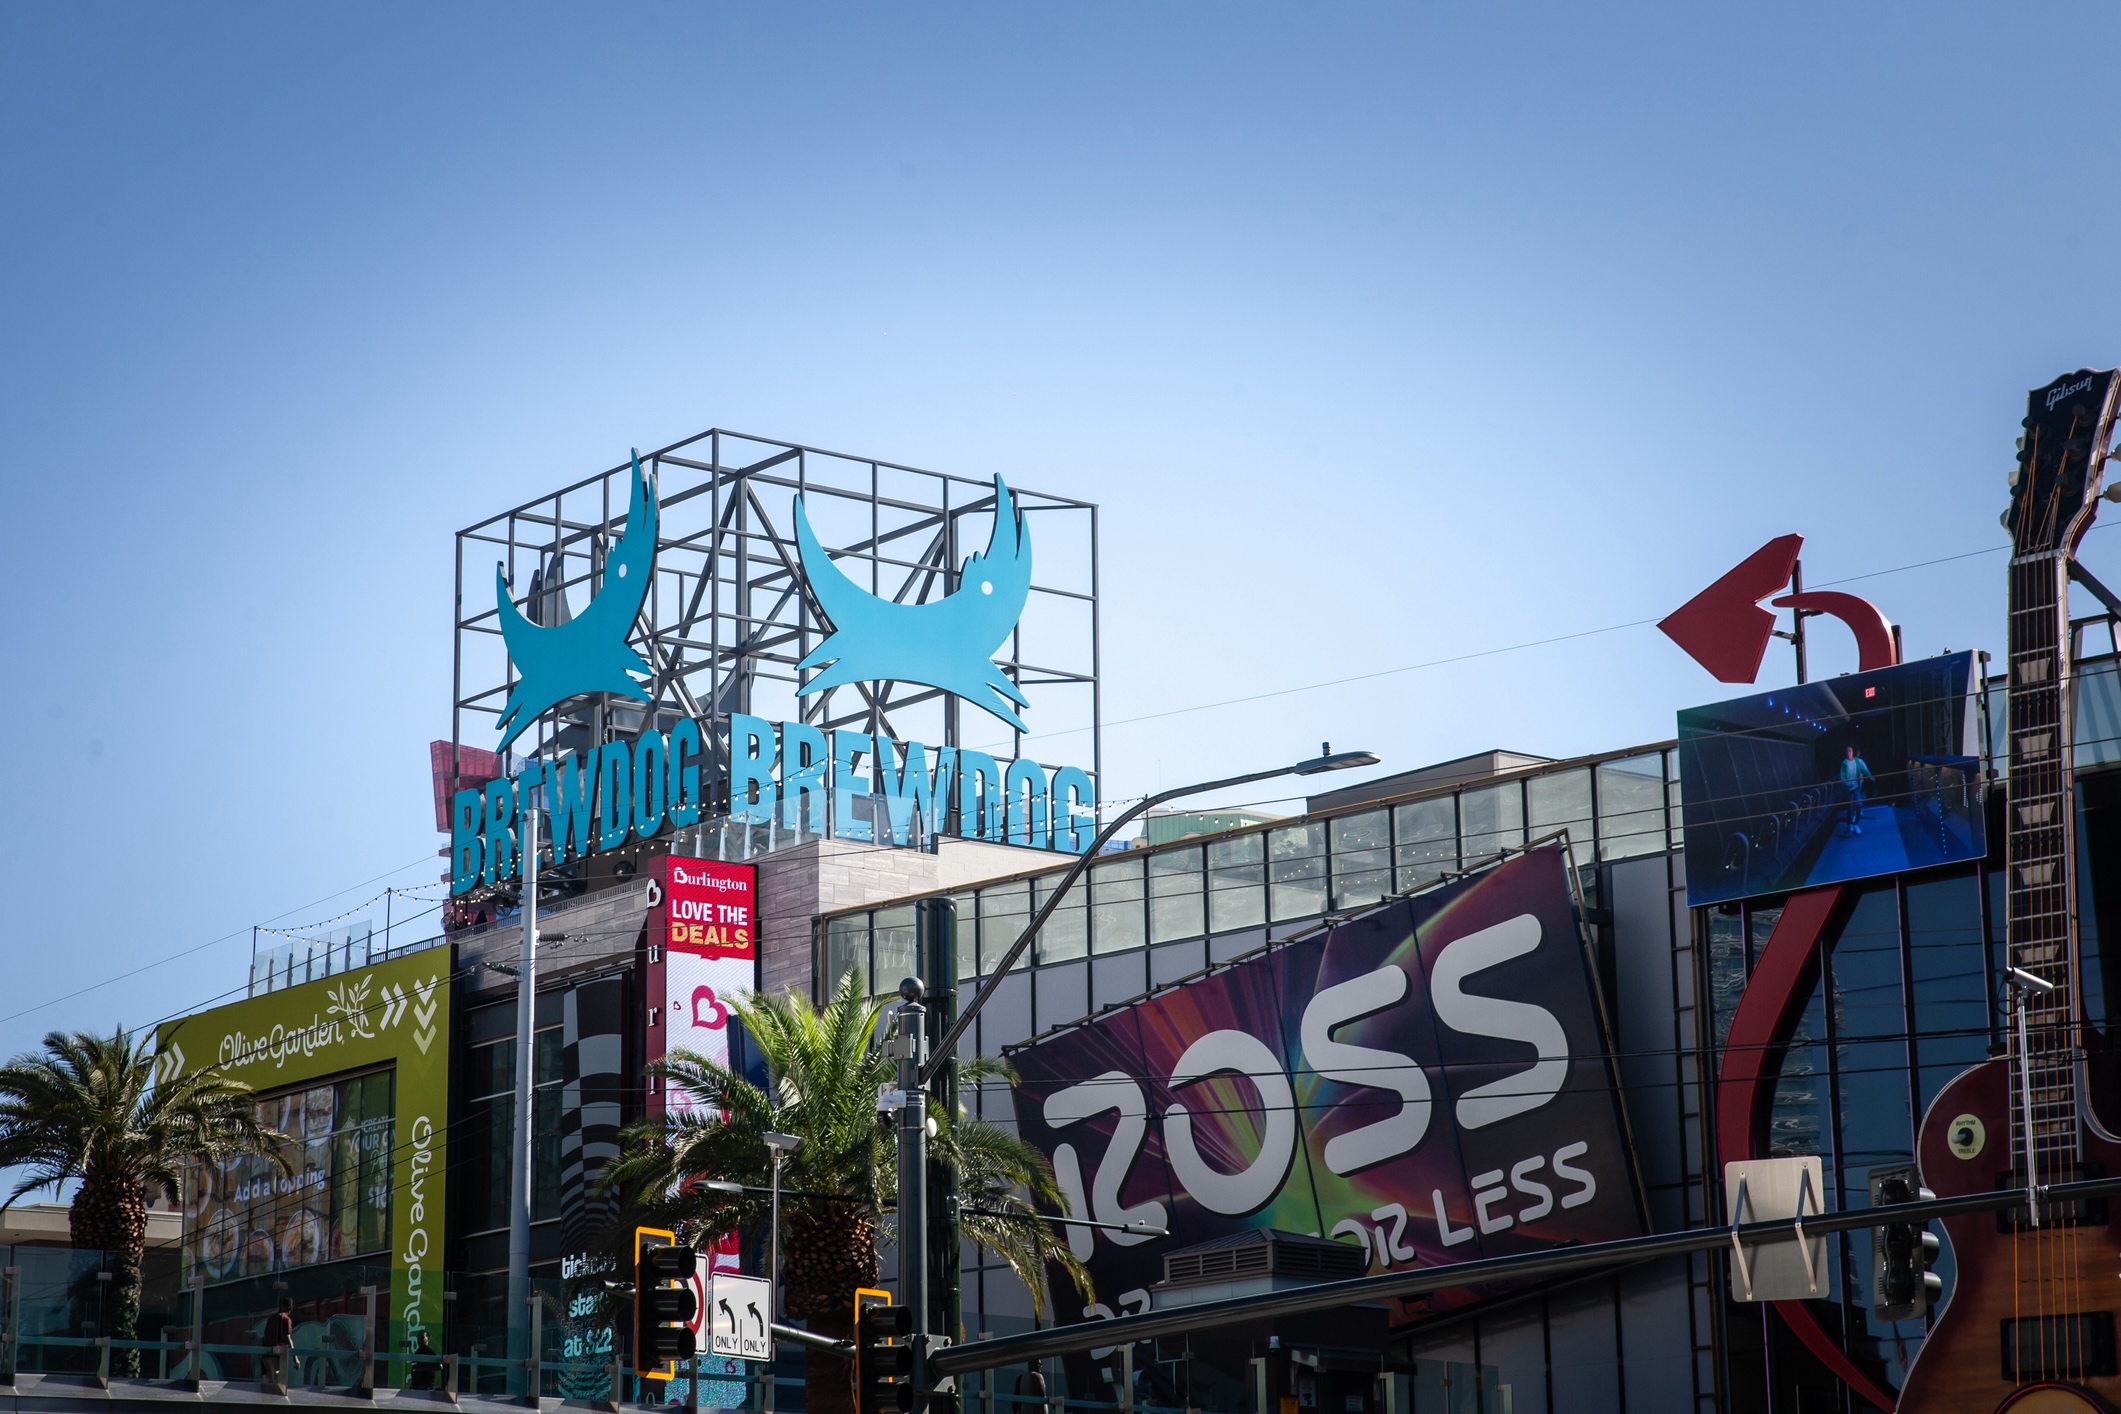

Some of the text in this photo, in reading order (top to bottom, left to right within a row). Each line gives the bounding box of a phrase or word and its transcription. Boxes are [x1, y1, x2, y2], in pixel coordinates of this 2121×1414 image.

[2045, 375, 2093, 412] Gibson
[730, 712, 1095, 855] BREWDOG
[453, 718, 701, 895] BREWDOG
[674, 866, 747, 893] Burlington
[672, 899, 748, 926] LOVE THE
[671, 921, 749, 950] DEALS
[218, 1013, 344, 1071] Olive Garden
[1043, 913, 1569, 1262] ROSS
[233, 1178, 260, 1203] Add
[263, 1181, 271, 1197] a
[1310, 1140, 1597, 1267] OR LESS
[403, 1115, 432, 1384] Olive Garde
[563, 1335, 583, 1358] at
[715, 1335, 767, 1353] ONLY ONLY
